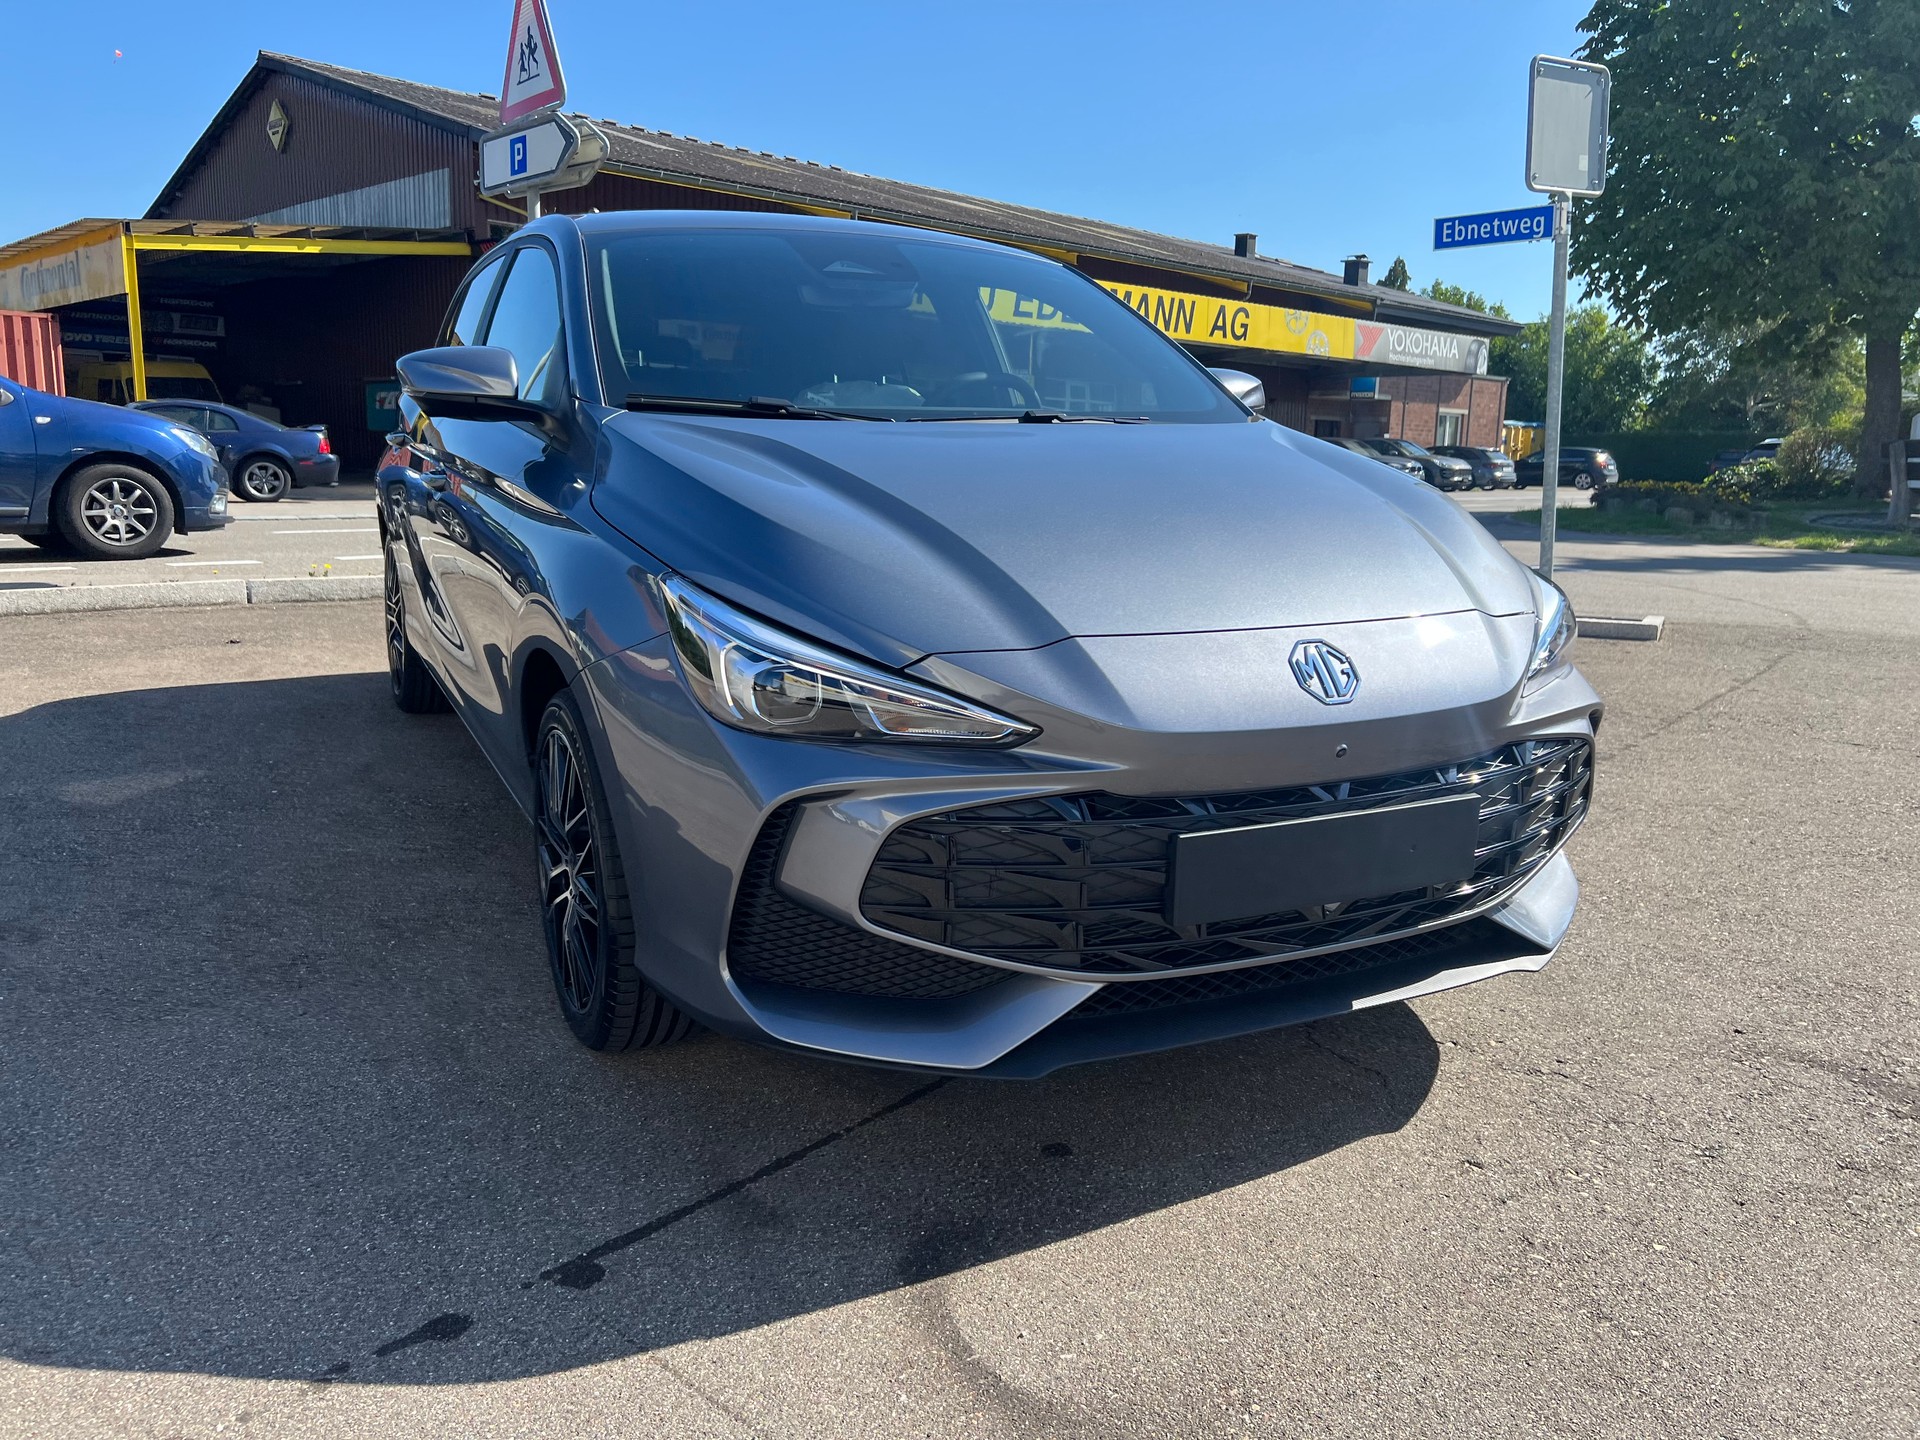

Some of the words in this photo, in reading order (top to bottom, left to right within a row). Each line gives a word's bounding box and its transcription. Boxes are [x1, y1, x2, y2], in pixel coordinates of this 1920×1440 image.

[514, 142, 523, 171] P
[1442, 216, 1545, 242] Ebnetweg
[20, 249, 81, 301] Continental
[63, 332, 92, 342] OYO
[1209, 304, 1251, 341] AG
[1387, 328, 1459, 359] YOKOHAMA
[1294, 645, 1355, 698] MG
